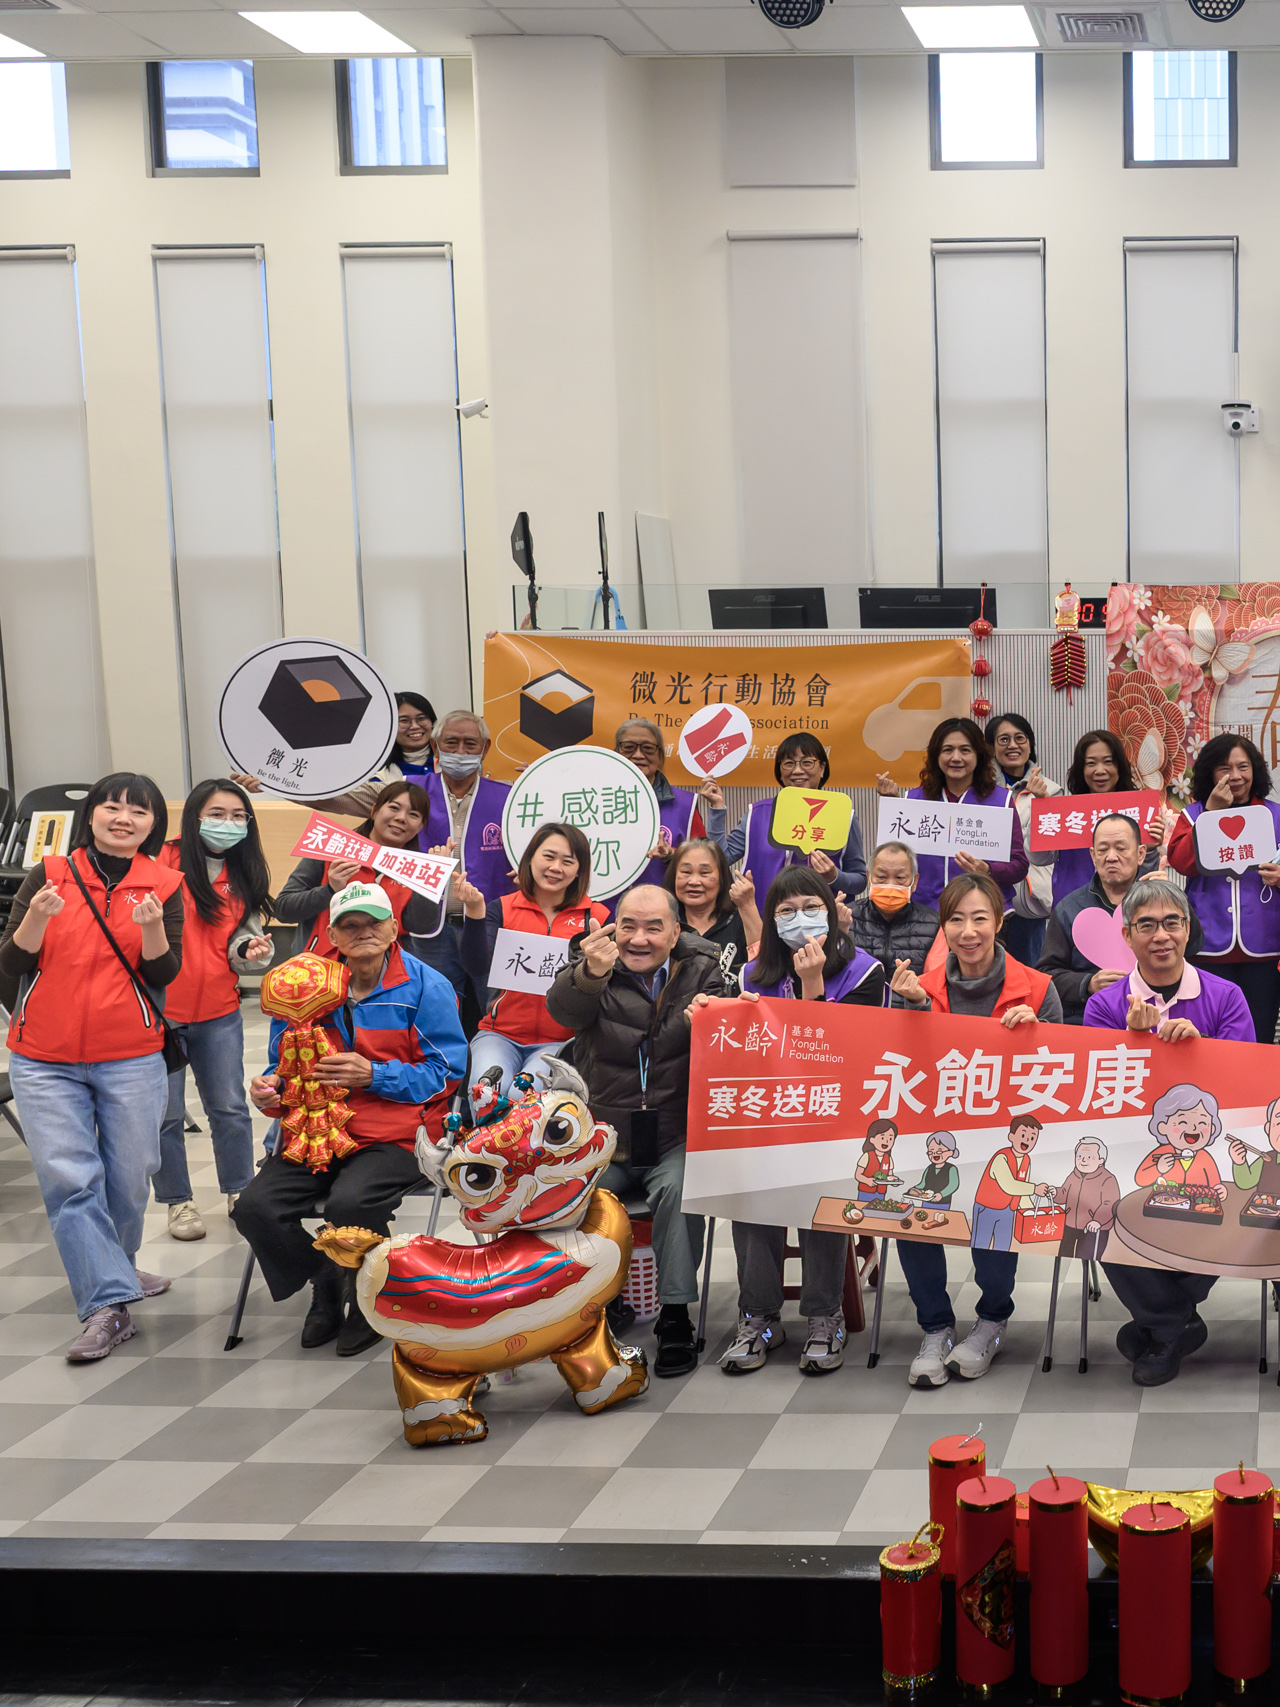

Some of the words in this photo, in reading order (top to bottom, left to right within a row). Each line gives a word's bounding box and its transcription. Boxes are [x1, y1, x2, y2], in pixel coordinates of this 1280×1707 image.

[629, 671, 832, 708] 微光行動協會
[654, 713, 683, 728] The
[749, 715, 829, 730] ssociation
[265, 747, 309, 778] 微光
[257, 768, 268, 778] Be
[268, 772, 281, 783] the
[281, 776, 301, 790] light.
[559, 784, 641, 828] 感謝
[889, 811, 946, 844] 永齡
[955, 817, 984, 829] 基金會
[791, 824, 827, 843] 分享
[954, 837, 1000, 849] Foundation
[955, 828, 988, 839] YongLin
[302, 824, 374, 862] 永齡社福
[379, 851, 446, 889] 加油站
[1218, 843, 1255, 863] 按讚
[709, 1018, 779, 1058] 永齡
[791, 1024, 826, 1039] 基金會
[790, 1038, 830, 1051] YongLin
[788, 1049, 844, 1064] Foundation
[859, 1043, 1152, 1119] 永飽安康
[706, 1083, 843, 1120] 寒冬送暖
[1030, 1221, 1059, 1237] 永齡
